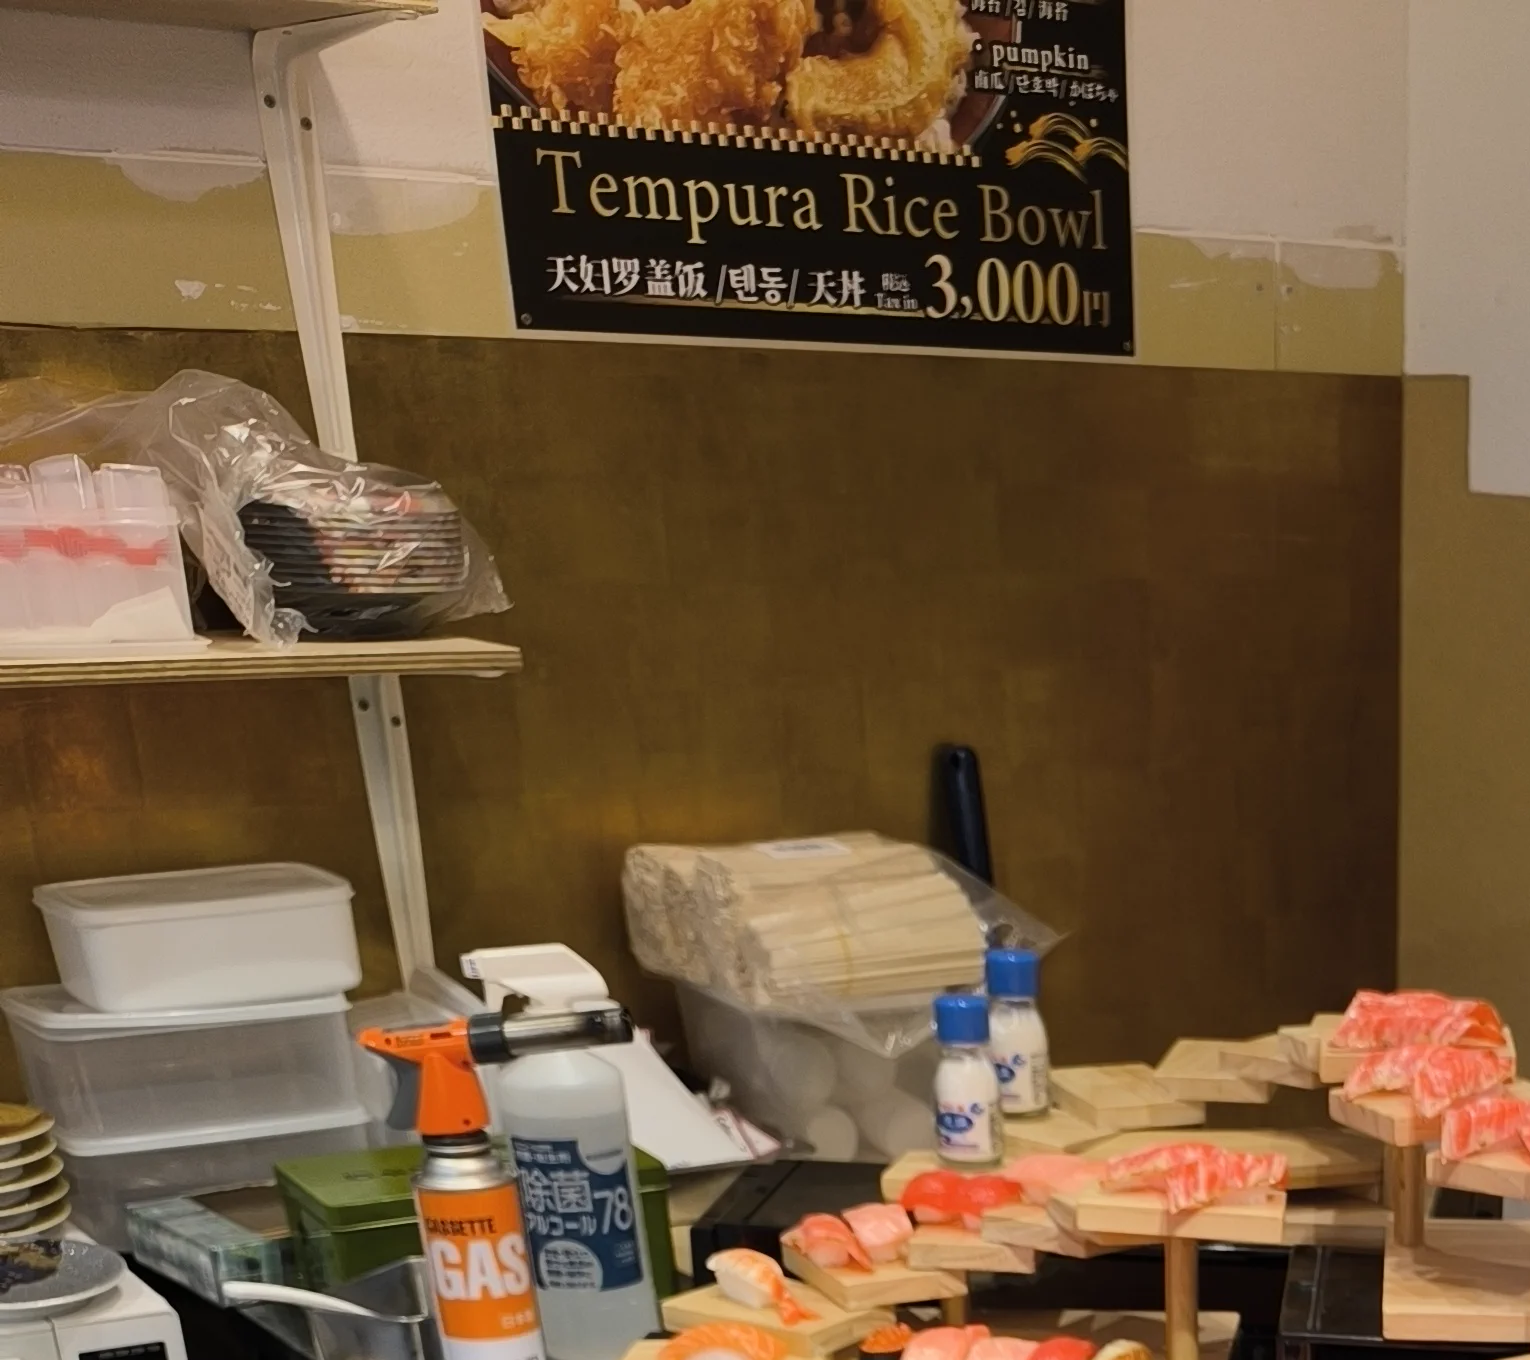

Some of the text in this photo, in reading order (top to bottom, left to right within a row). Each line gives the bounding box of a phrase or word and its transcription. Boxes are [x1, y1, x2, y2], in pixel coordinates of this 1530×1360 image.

[992, 44, 1090, 72] pumpkin
[535, 147, 1107, 250] Tempura Rice Bowl
[924, 253, 1111, 327] 3,000円
[519, 1167, 594, 1214] 除菌
[593, 1186, 634, 1236] 78
[429, 1232, 532, 1301] GAS
